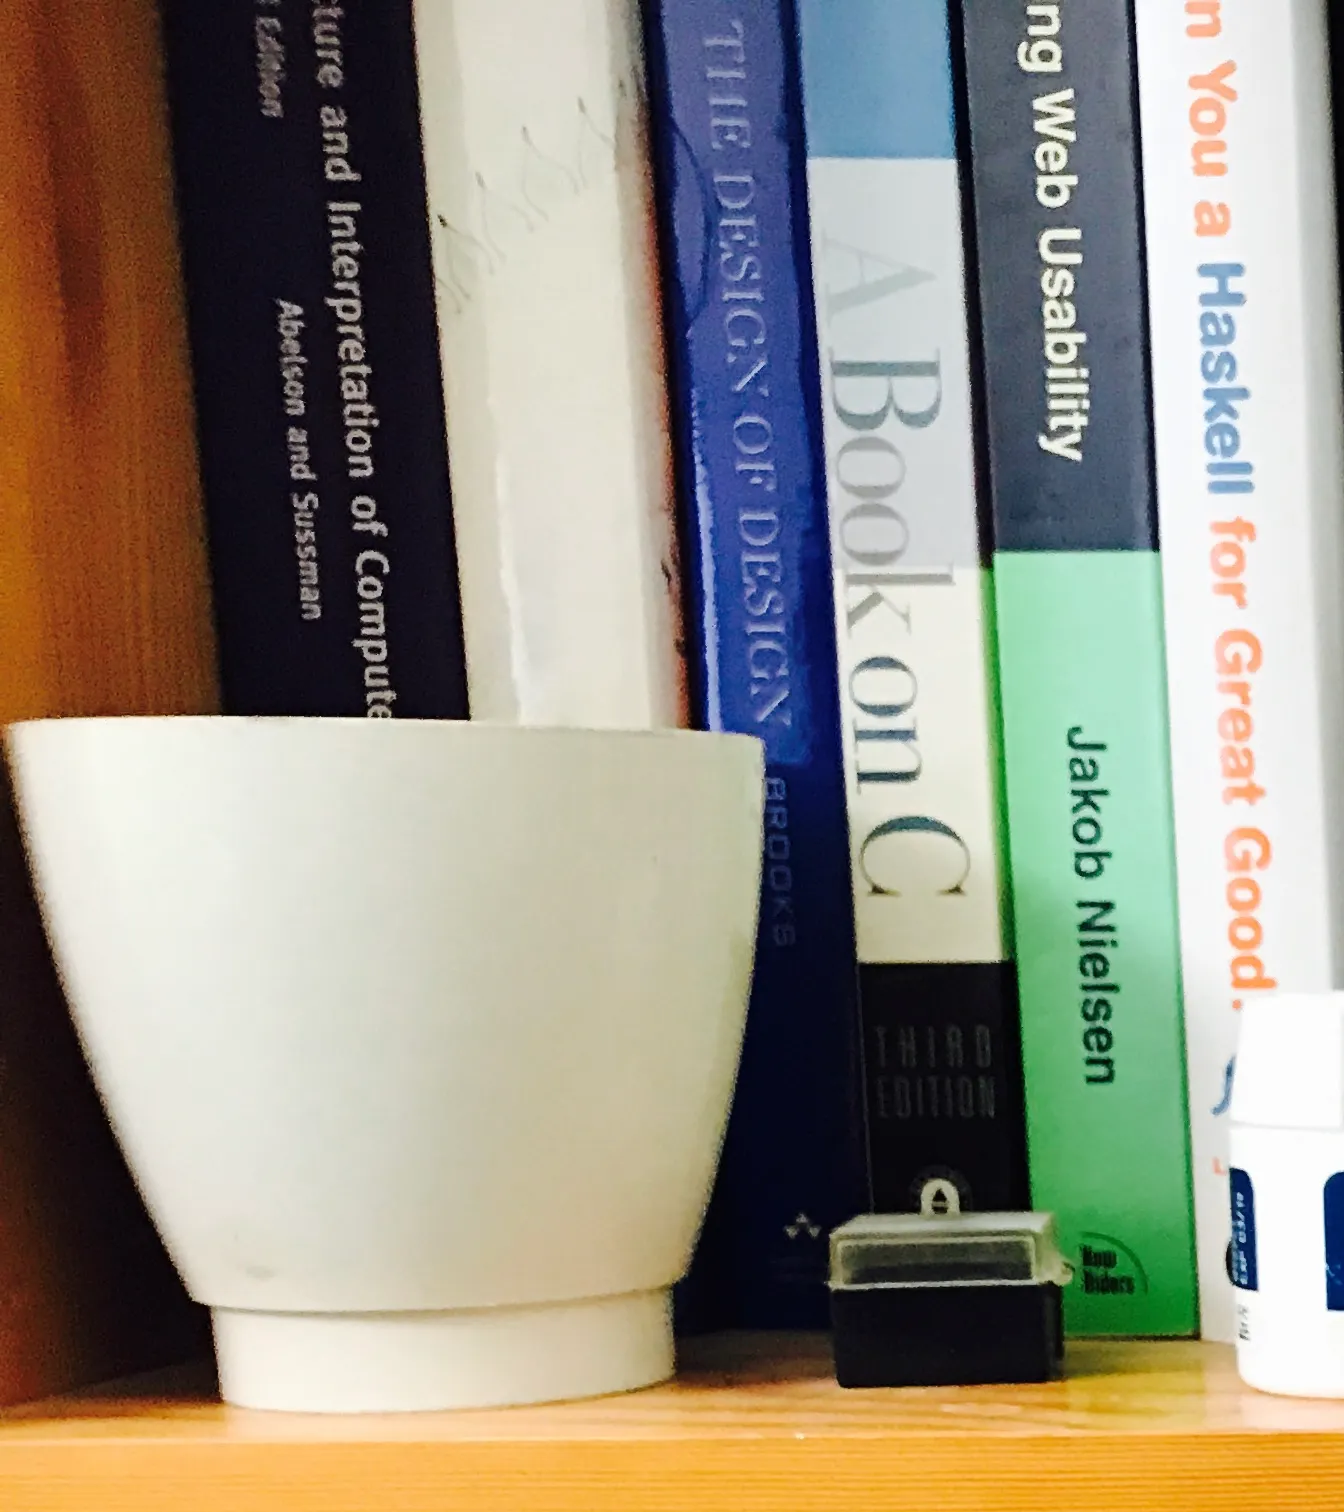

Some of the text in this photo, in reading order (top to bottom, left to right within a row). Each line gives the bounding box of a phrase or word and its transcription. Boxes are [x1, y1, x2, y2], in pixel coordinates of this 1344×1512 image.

[1029, 88, 1078, 209] Web
[1185, 61, 1237, 177] You
[1194, 201, 1231, 238] a
[319, 105, 389, 537] and Interpretation of
[1036, 229, 1091, 462] Usability
[1198, 262, 1256, 494] Haskell
[278, 299, 321, 621] Abelson and Sussman
[1210, 515, 1258, 610] for
[1213, 628, 1268, 806] Great
[1067, 726, 1117, 1085] Jakob Nielsen
